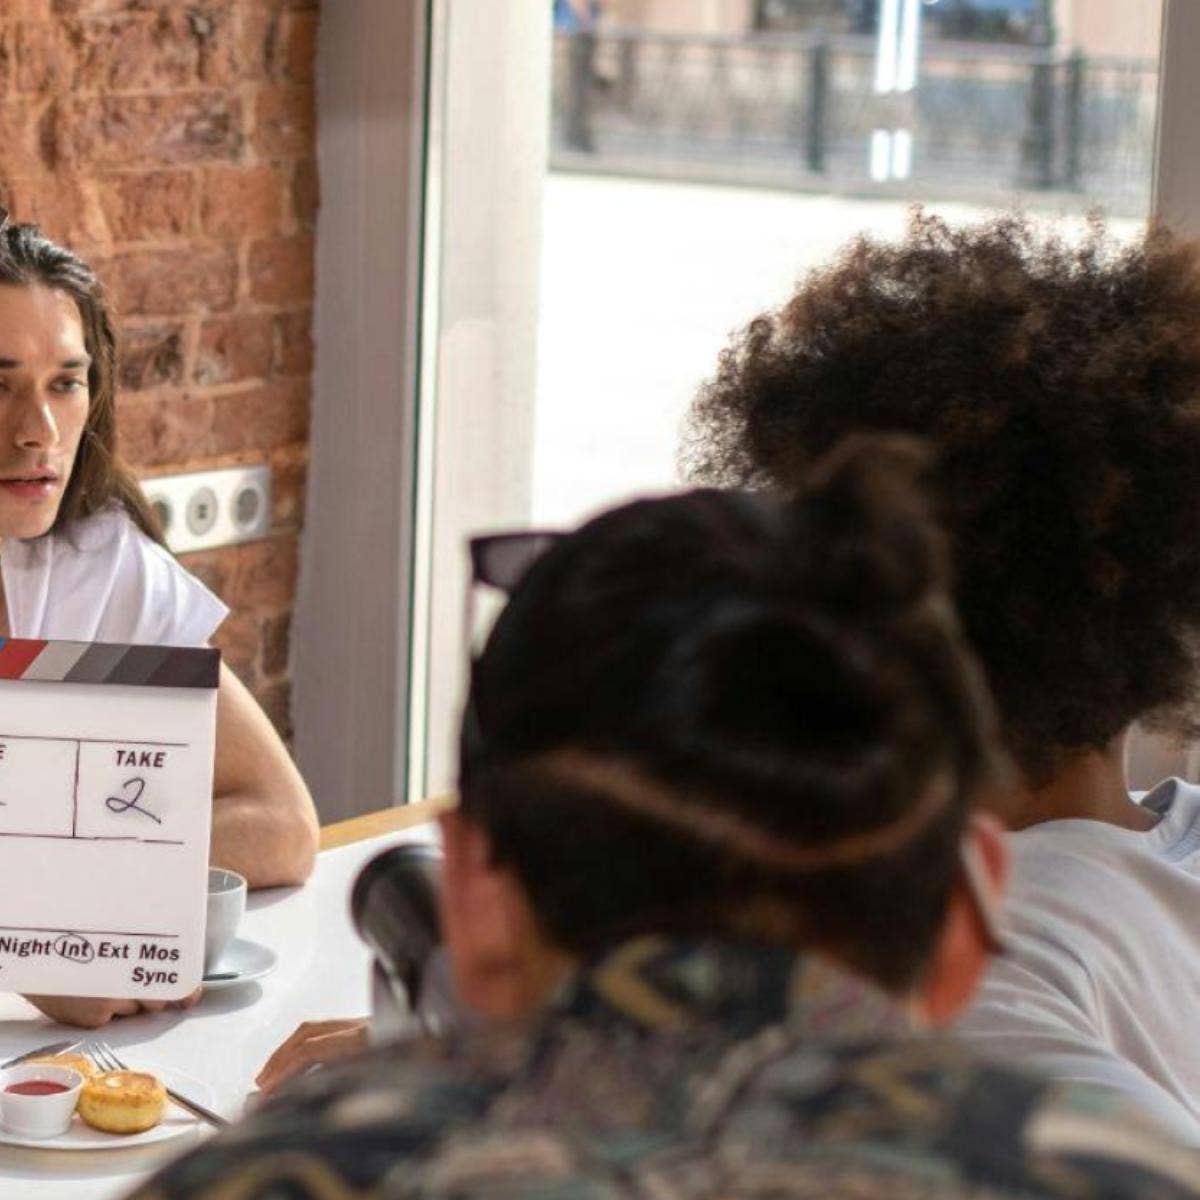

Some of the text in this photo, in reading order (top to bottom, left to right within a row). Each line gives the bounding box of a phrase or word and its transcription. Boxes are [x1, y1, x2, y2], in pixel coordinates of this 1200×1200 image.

[115, 750, 166, 768] TAKE
[105, 776, 162, 825] 2
[61, 940, 89, 957] Int
[97, 941, 130, 959] Ext
[138, 943, 180, 961] Mos
[131, 966, 179, 987] Sync
